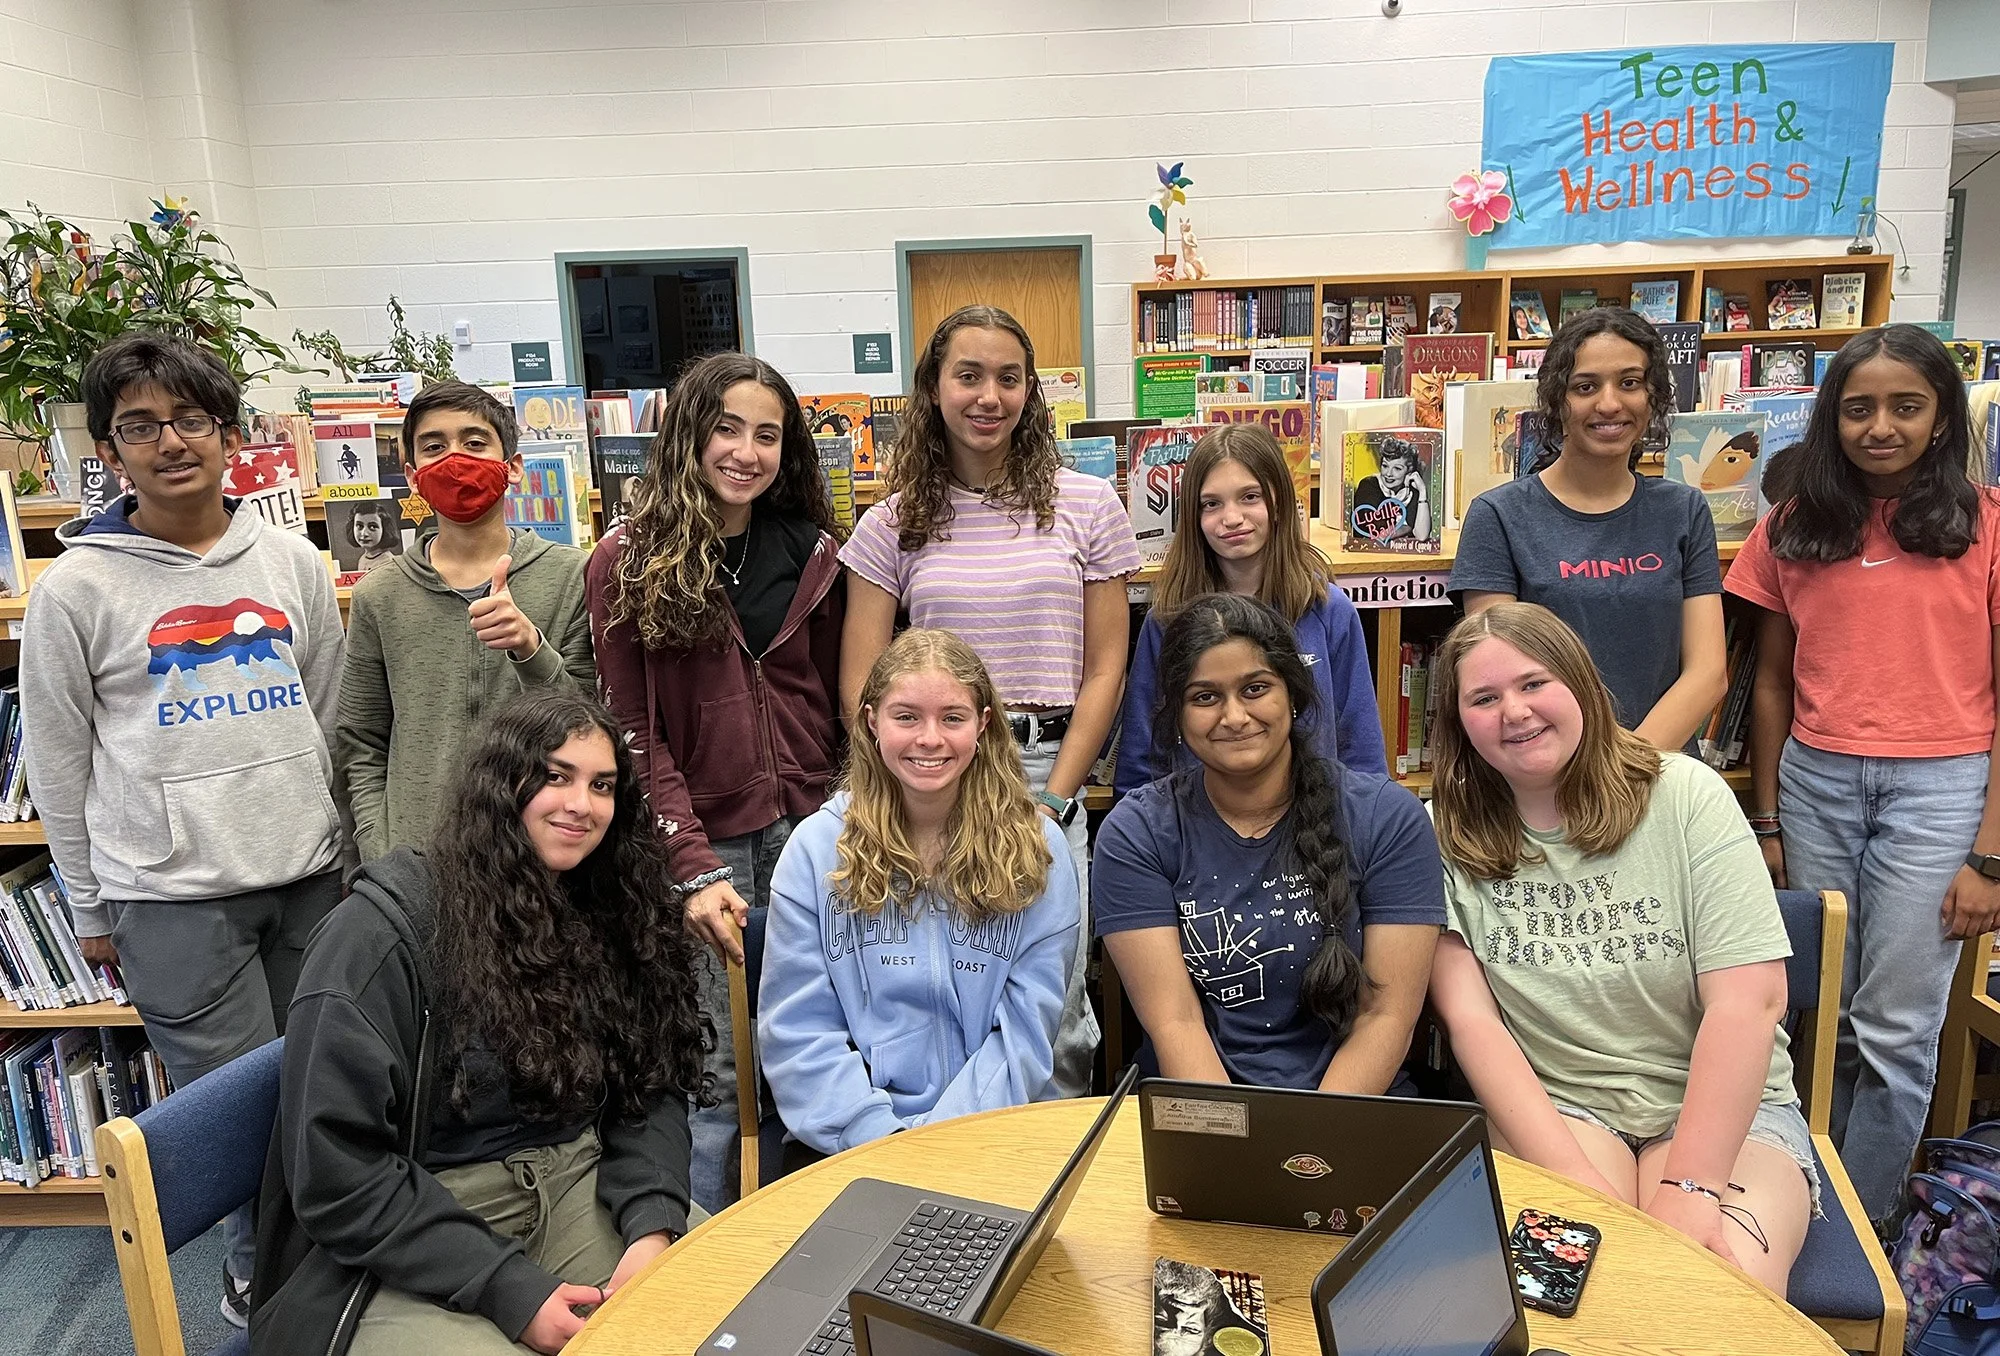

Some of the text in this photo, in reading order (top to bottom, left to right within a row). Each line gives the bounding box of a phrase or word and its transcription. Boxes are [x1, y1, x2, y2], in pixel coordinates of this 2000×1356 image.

[1620, 51, 1767, 100] Teen
[1581, 100, 1804, 157] Health &
[1558, 159, 1811, 215] Wellness
[1825, 277, 1862, 286] Diabetes
[1413, 344, 1478, 364] DRAGONS
[1761, 350, 1808, 369] IDEAS
[1256, 360, 1305, 371] SOCCER
[872, 398, 908, 412] ATTUC
[332, 424, 352, 437] All
[1174, 432, 1190, 444] THE
[1150, 444, 1194, 464] FAITHF
[604, 460, 640, 474] Marie
[329, 486, 372, 499] about
[250, 488, 299, 526] OTE!
[504, 497, 564, 522] NTHONY
[1354, 502, 1400, 526] Lucille
[1366, 518, 1396, 540] Ball
[1146, 552, 1165, 562] JOH
[1559, 553, 1662, 578] MINIO
[1340, 576, 1445, 602] nfictio
[158, 682, 302, 727] EXPLORE
[1262, 872, 1306, 888] our legac
[1492, 871, 1618, 916] grow
[1270, 908, 1286, 918] the
[1294, 907, 1324, 926] sta
[1523, 896, 1664, 938] more
[1486, 926, 1686, 967] flowers
[880, 955, 916, 966] WEST
[104, 1061, 121, 1114] BEYON
